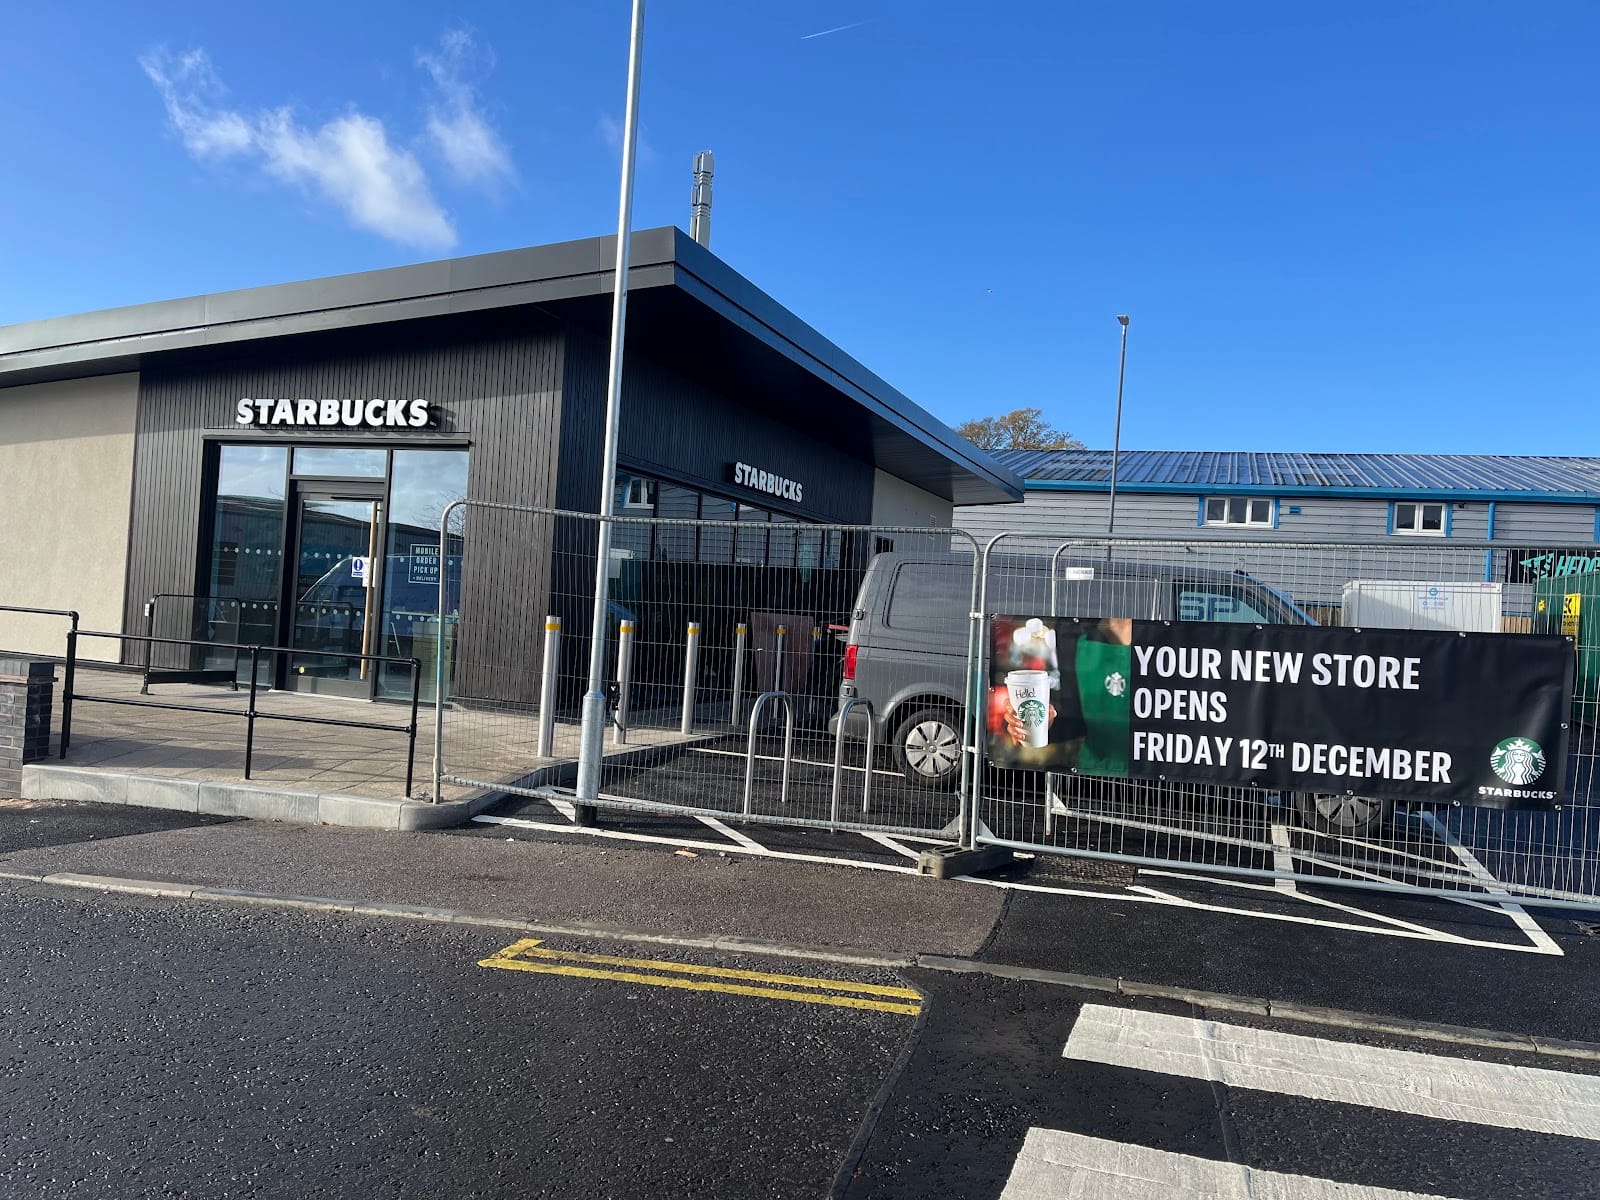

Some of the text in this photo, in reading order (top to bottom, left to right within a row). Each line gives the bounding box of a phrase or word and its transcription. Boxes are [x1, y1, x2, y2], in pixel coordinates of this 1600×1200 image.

[236, 398, 429, 427] STARBUCKS
[734, 461, 803, 503] STARBUCKS
[415, 547, 440, 555] MOBILE
[415, 556, 437, 565] ORDER
[413, 565, 439, 575] PICK UP
[1134, 645, 1421, 690] YOUR NEW STORE
[1133, 687, 1228, 723] OPENS
[1133, 731, 1452, 784] FRIDAY 12TH DECEMBER
[1478, 786, 1555, 799] STARBUCKS
